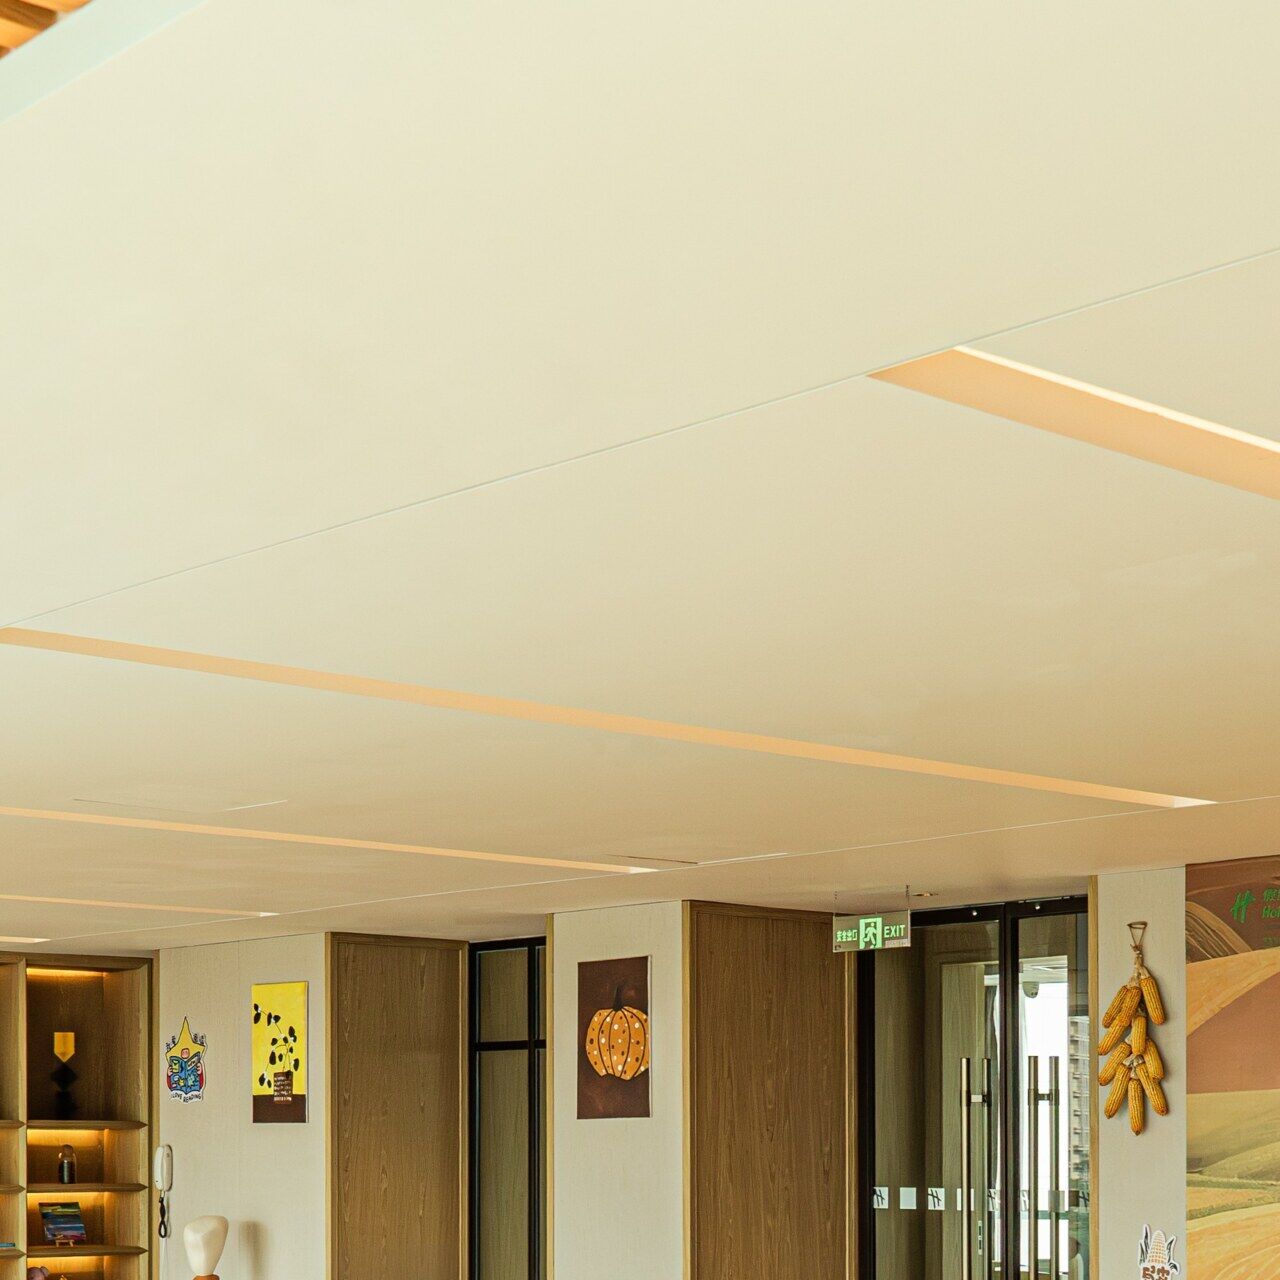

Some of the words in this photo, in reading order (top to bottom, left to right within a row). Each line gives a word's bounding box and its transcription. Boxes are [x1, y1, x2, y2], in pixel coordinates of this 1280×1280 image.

[836, 929, 858, 942] 安全出口
[884, 925, 906, 938] EXIT
